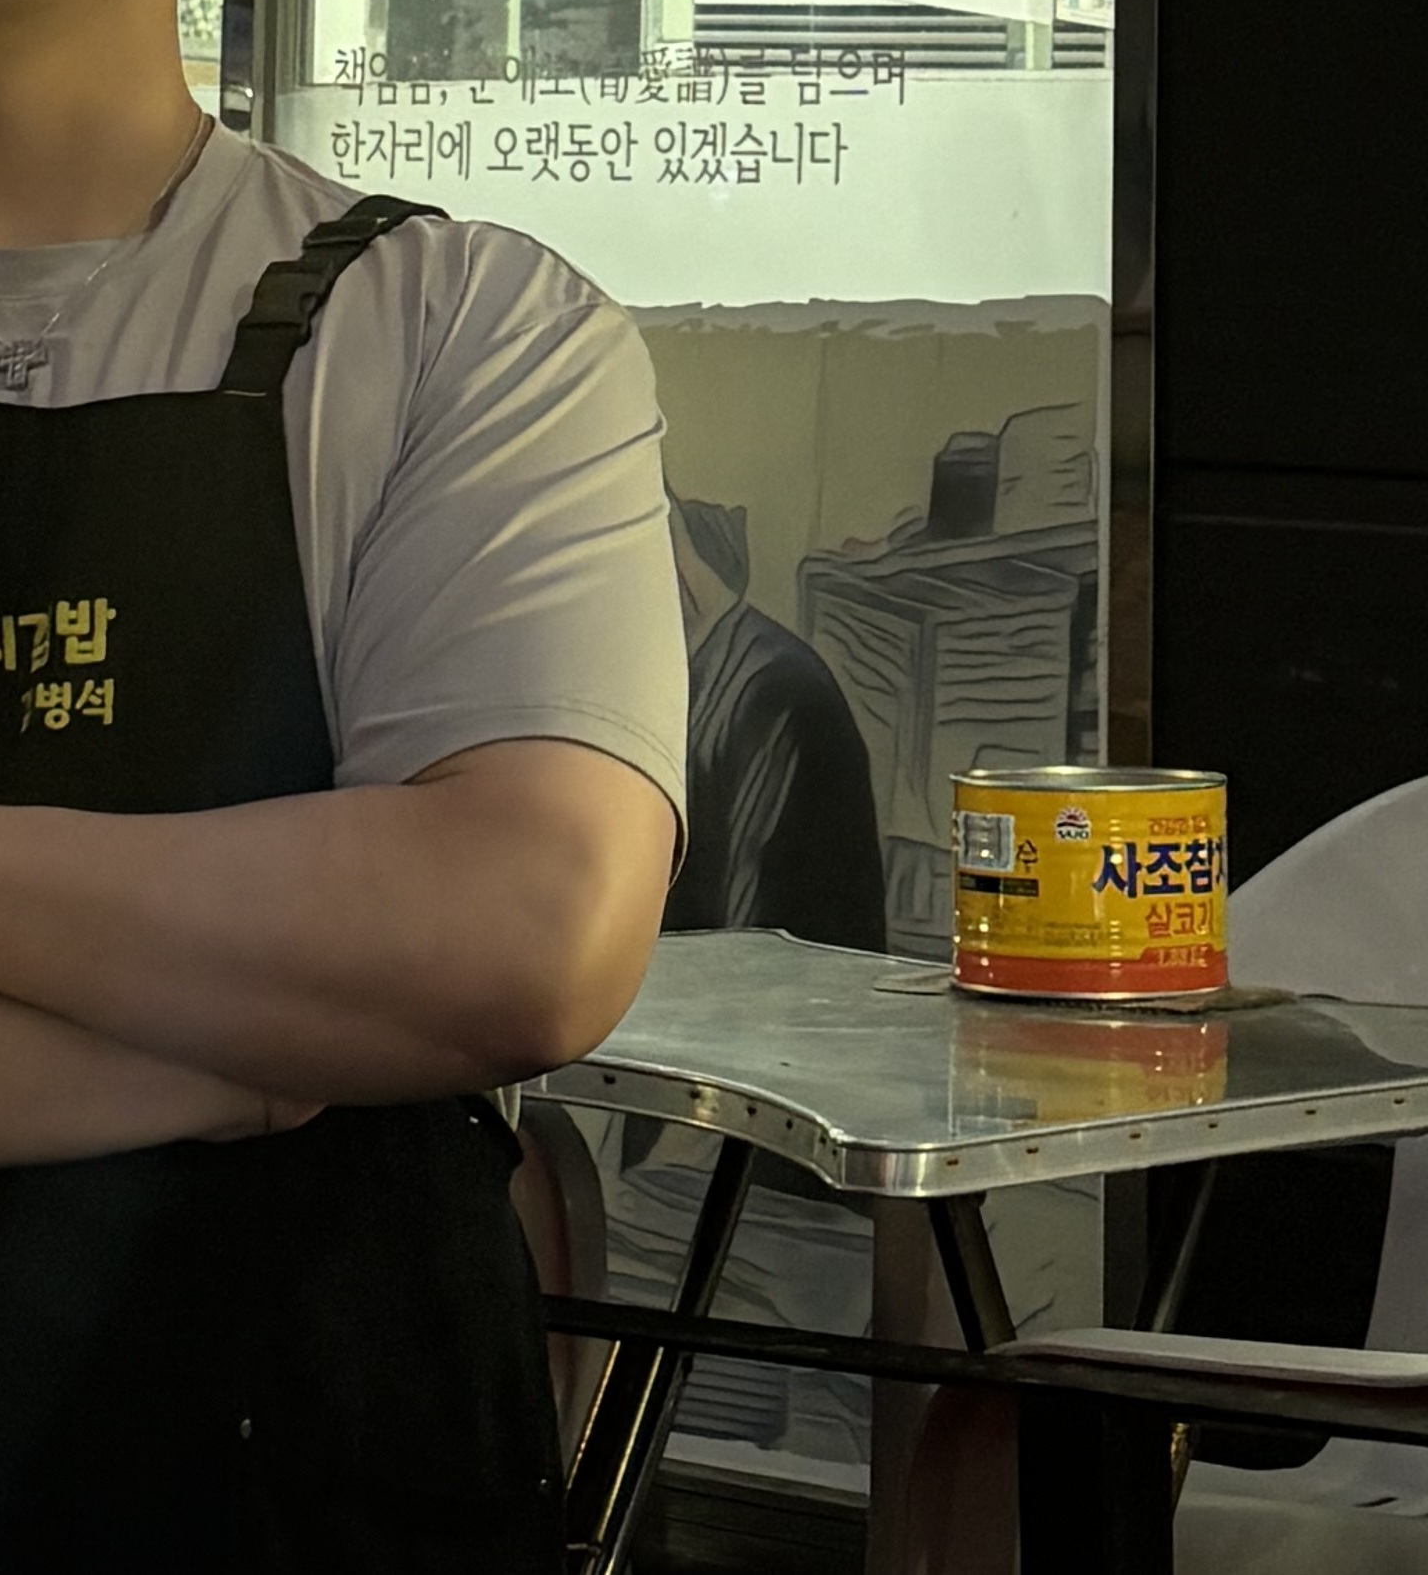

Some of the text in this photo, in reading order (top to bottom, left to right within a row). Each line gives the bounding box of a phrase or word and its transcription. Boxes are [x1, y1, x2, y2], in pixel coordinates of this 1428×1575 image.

[330, 120, 849, 187] 한자리에 오랫동안 있겠습니다
[20, 677, 115, 734] 병석
